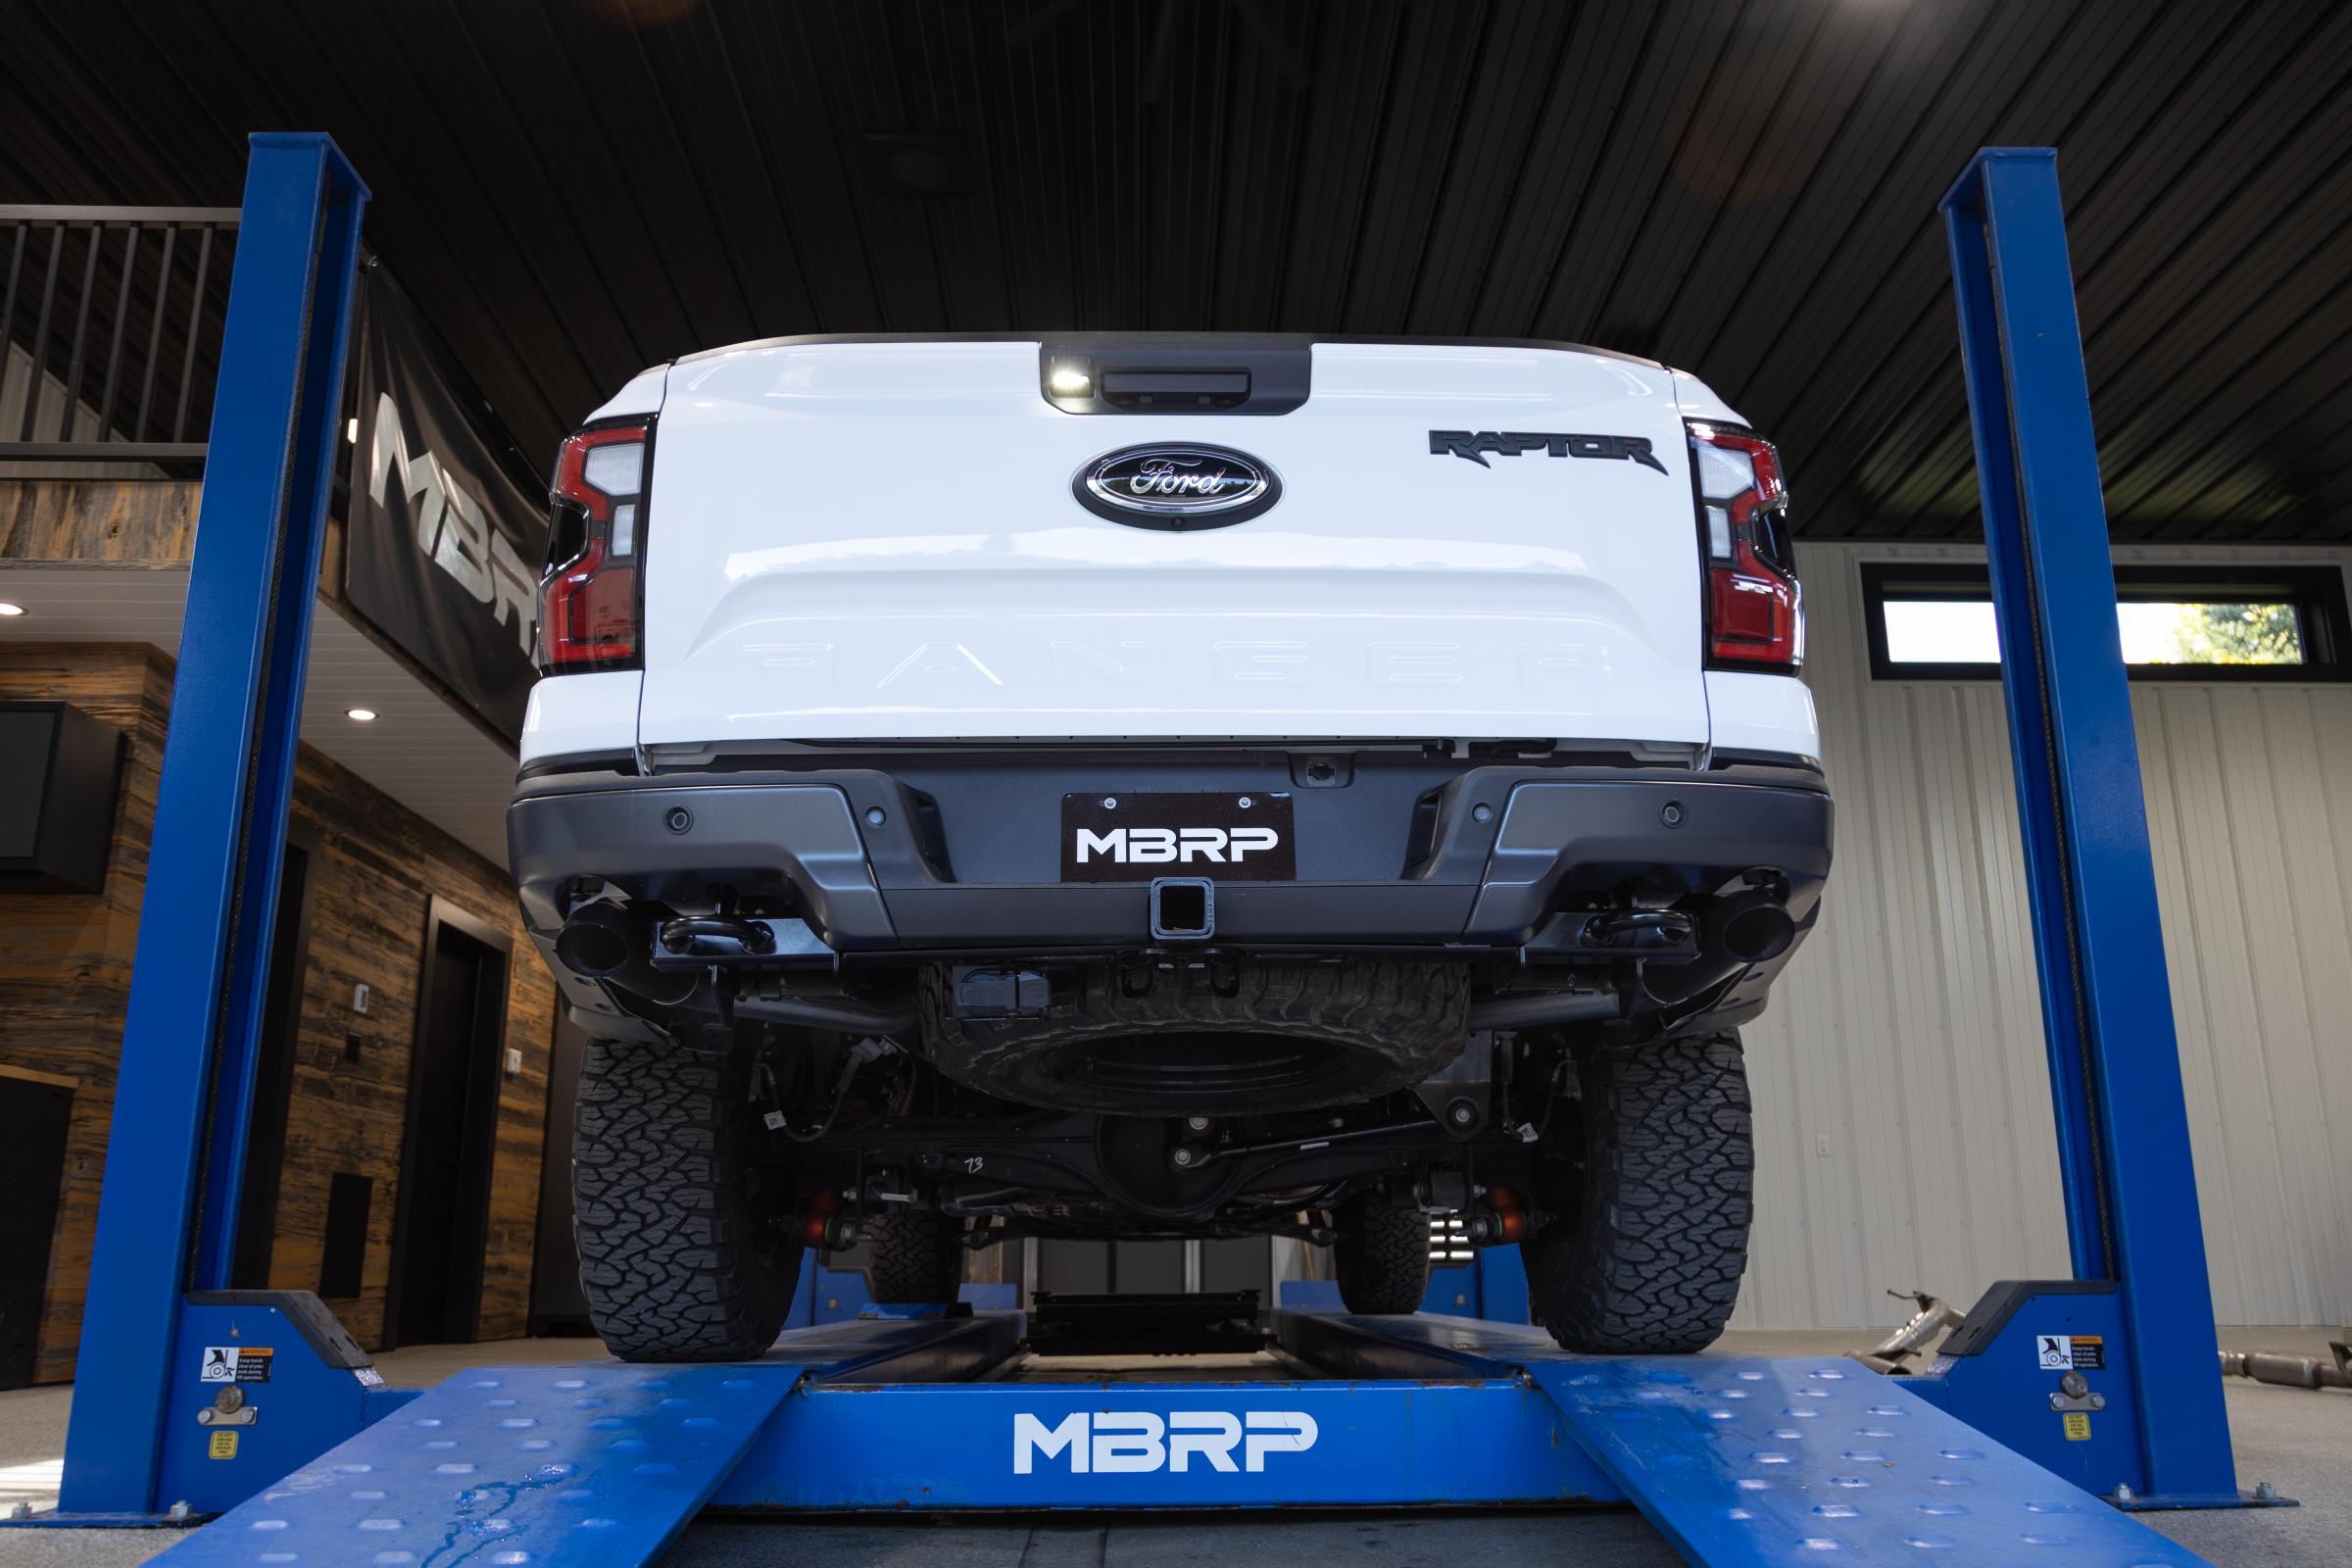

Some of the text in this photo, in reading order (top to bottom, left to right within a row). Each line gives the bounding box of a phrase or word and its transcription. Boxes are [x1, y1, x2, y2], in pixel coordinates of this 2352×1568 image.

[1429, 429, 1669, 476] RAPTOR
[1130, 459, 1226, 494] Ford
[369, 392, 540, 670] MBR
[1076, 827, 1279, 862] MBRP
[1013, 1411, 1318, 1474] MBRP
